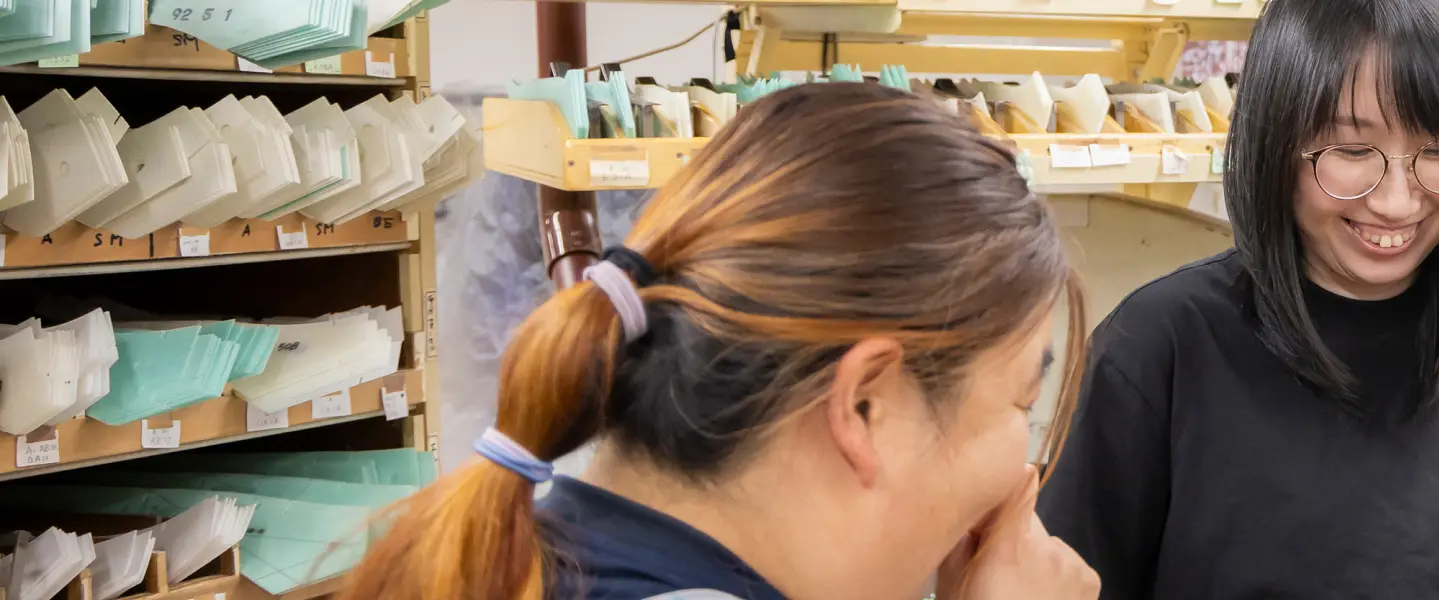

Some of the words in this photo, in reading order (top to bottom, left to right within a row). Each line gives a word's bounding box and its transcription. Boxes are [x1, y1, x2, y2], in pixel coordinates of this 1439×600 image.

[172, 7, 193, 21] 92
[202, 7, 215, 21] 5
[224, 8, 233, 21] 1
[172, 33, 200, 52] SM
[241, 223, 251, 237] A
[315, 222, 335, 236] SM
[41, 233, 53, 245] A
